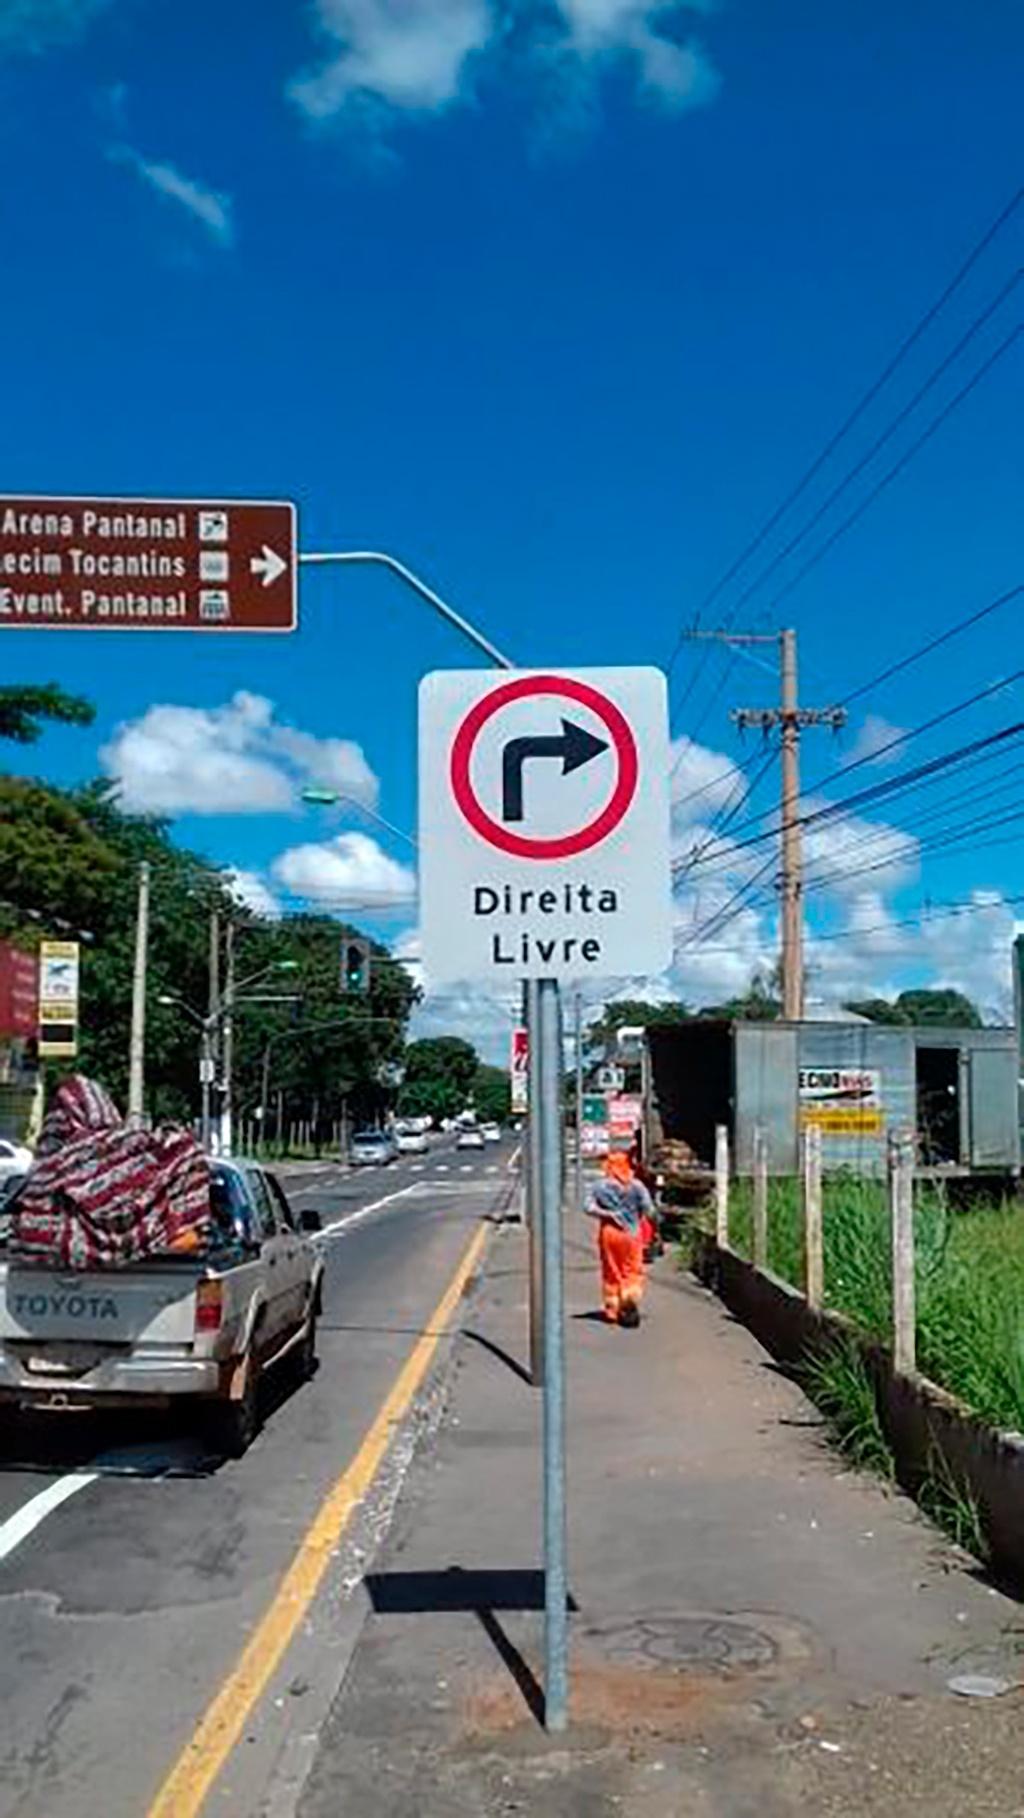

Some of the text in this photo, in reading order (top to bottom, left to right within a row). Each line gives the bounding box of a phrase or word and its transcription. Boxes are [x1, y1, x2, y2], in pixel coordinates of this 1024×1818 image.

[2, 508, 187, 538] Arena Pantanal
[0, 547, 187, 577] ecim Tocantins
[0, 587, 188, 617] Event. Pantanal
[474, 883, 618, 915] Direita
[493, 933, 601, 963] Livre
[14, 1294, 119, 1319] TOYOTA
